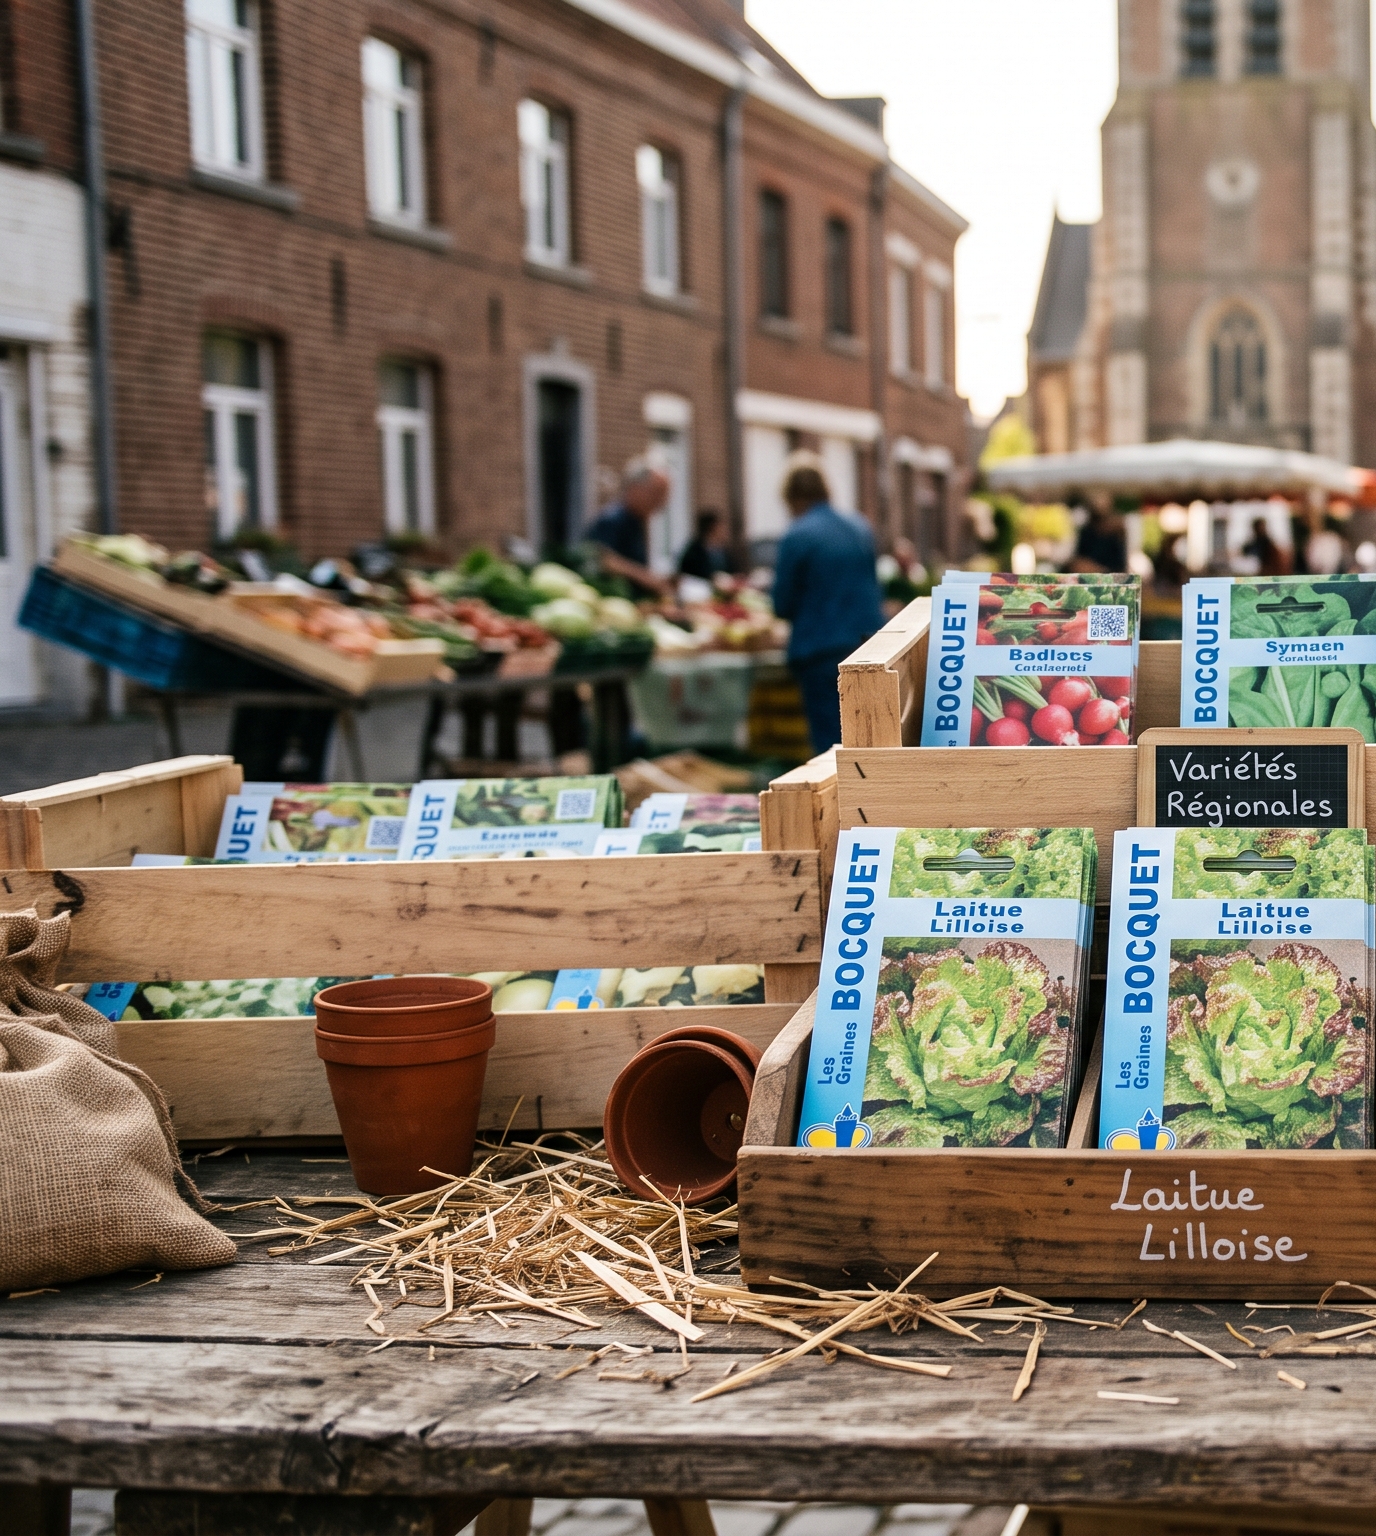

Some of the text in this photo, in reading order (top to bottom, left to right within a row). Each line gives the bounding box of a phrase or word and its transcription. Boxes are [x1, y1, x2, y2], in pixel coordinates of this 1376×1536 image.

[934, 598, 967, 731] BOCQUET
[1193, 593, 1220, 723] BOCQUET
[1168, 751, 1298, 782] Variétés
[1166, 788, 1334, 828] Régionales
[830, 842, 881, 1011] BOCQUET
[930, 918, 1025, 934] Lilloise
[935, 901, 1023, 918] Laitue
[1122, 843, 1161, 1014] BOCQUET
[1217, 920, 1313, 935] Lilloise
[1221, 902, 1310, 918] Laitue
[817, 1056, 836, 1085] Les
[835, 1021, 858, 1085] Graines
[1133, 1024, 1152, 1090] Graines
[1114, 1060, 1132, 1089] Les
[1110, 1168, 1265, 1211] Laitue
[1139, 1221, 1308, 1262] Lilloise
